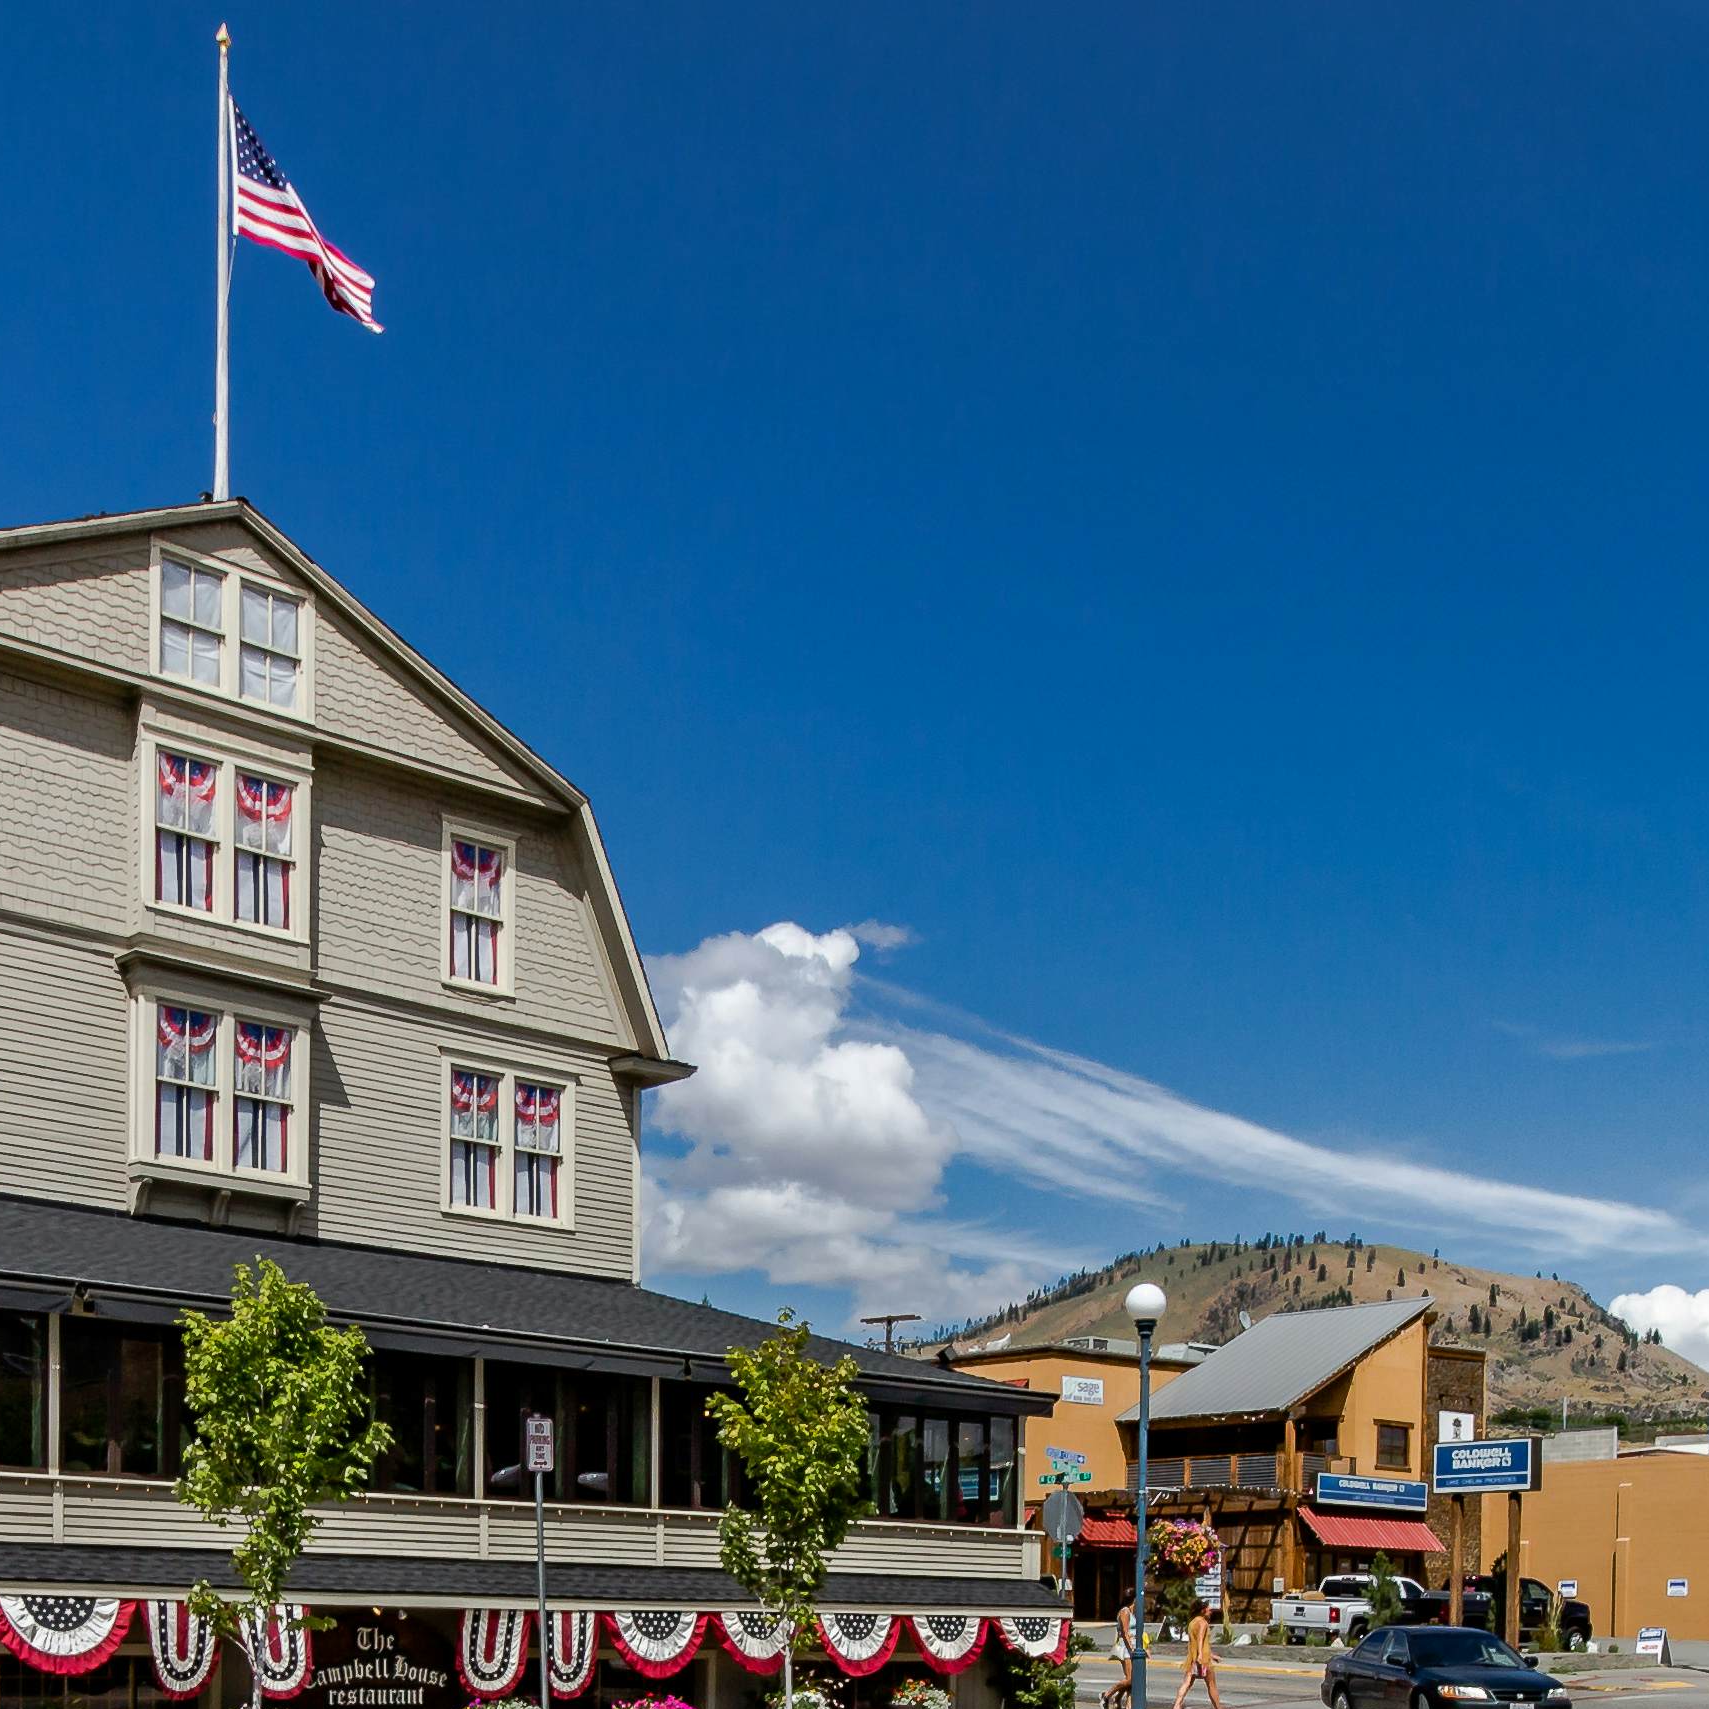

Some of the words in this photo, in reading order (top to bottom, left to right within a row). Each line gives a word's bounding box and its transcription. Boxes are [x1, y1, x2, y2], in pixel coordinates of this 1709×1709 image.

[1077, 1382, 1100, 1396] sage
[1452, 1447, 1511, 1460] COLDWELL
[1452, 1457, 1501, 1469] BANKER
[356, 1626, 395, 1653] The
[393, 1655, 448, 1687] House
[328, 1686, 425, 1705] restaurant
